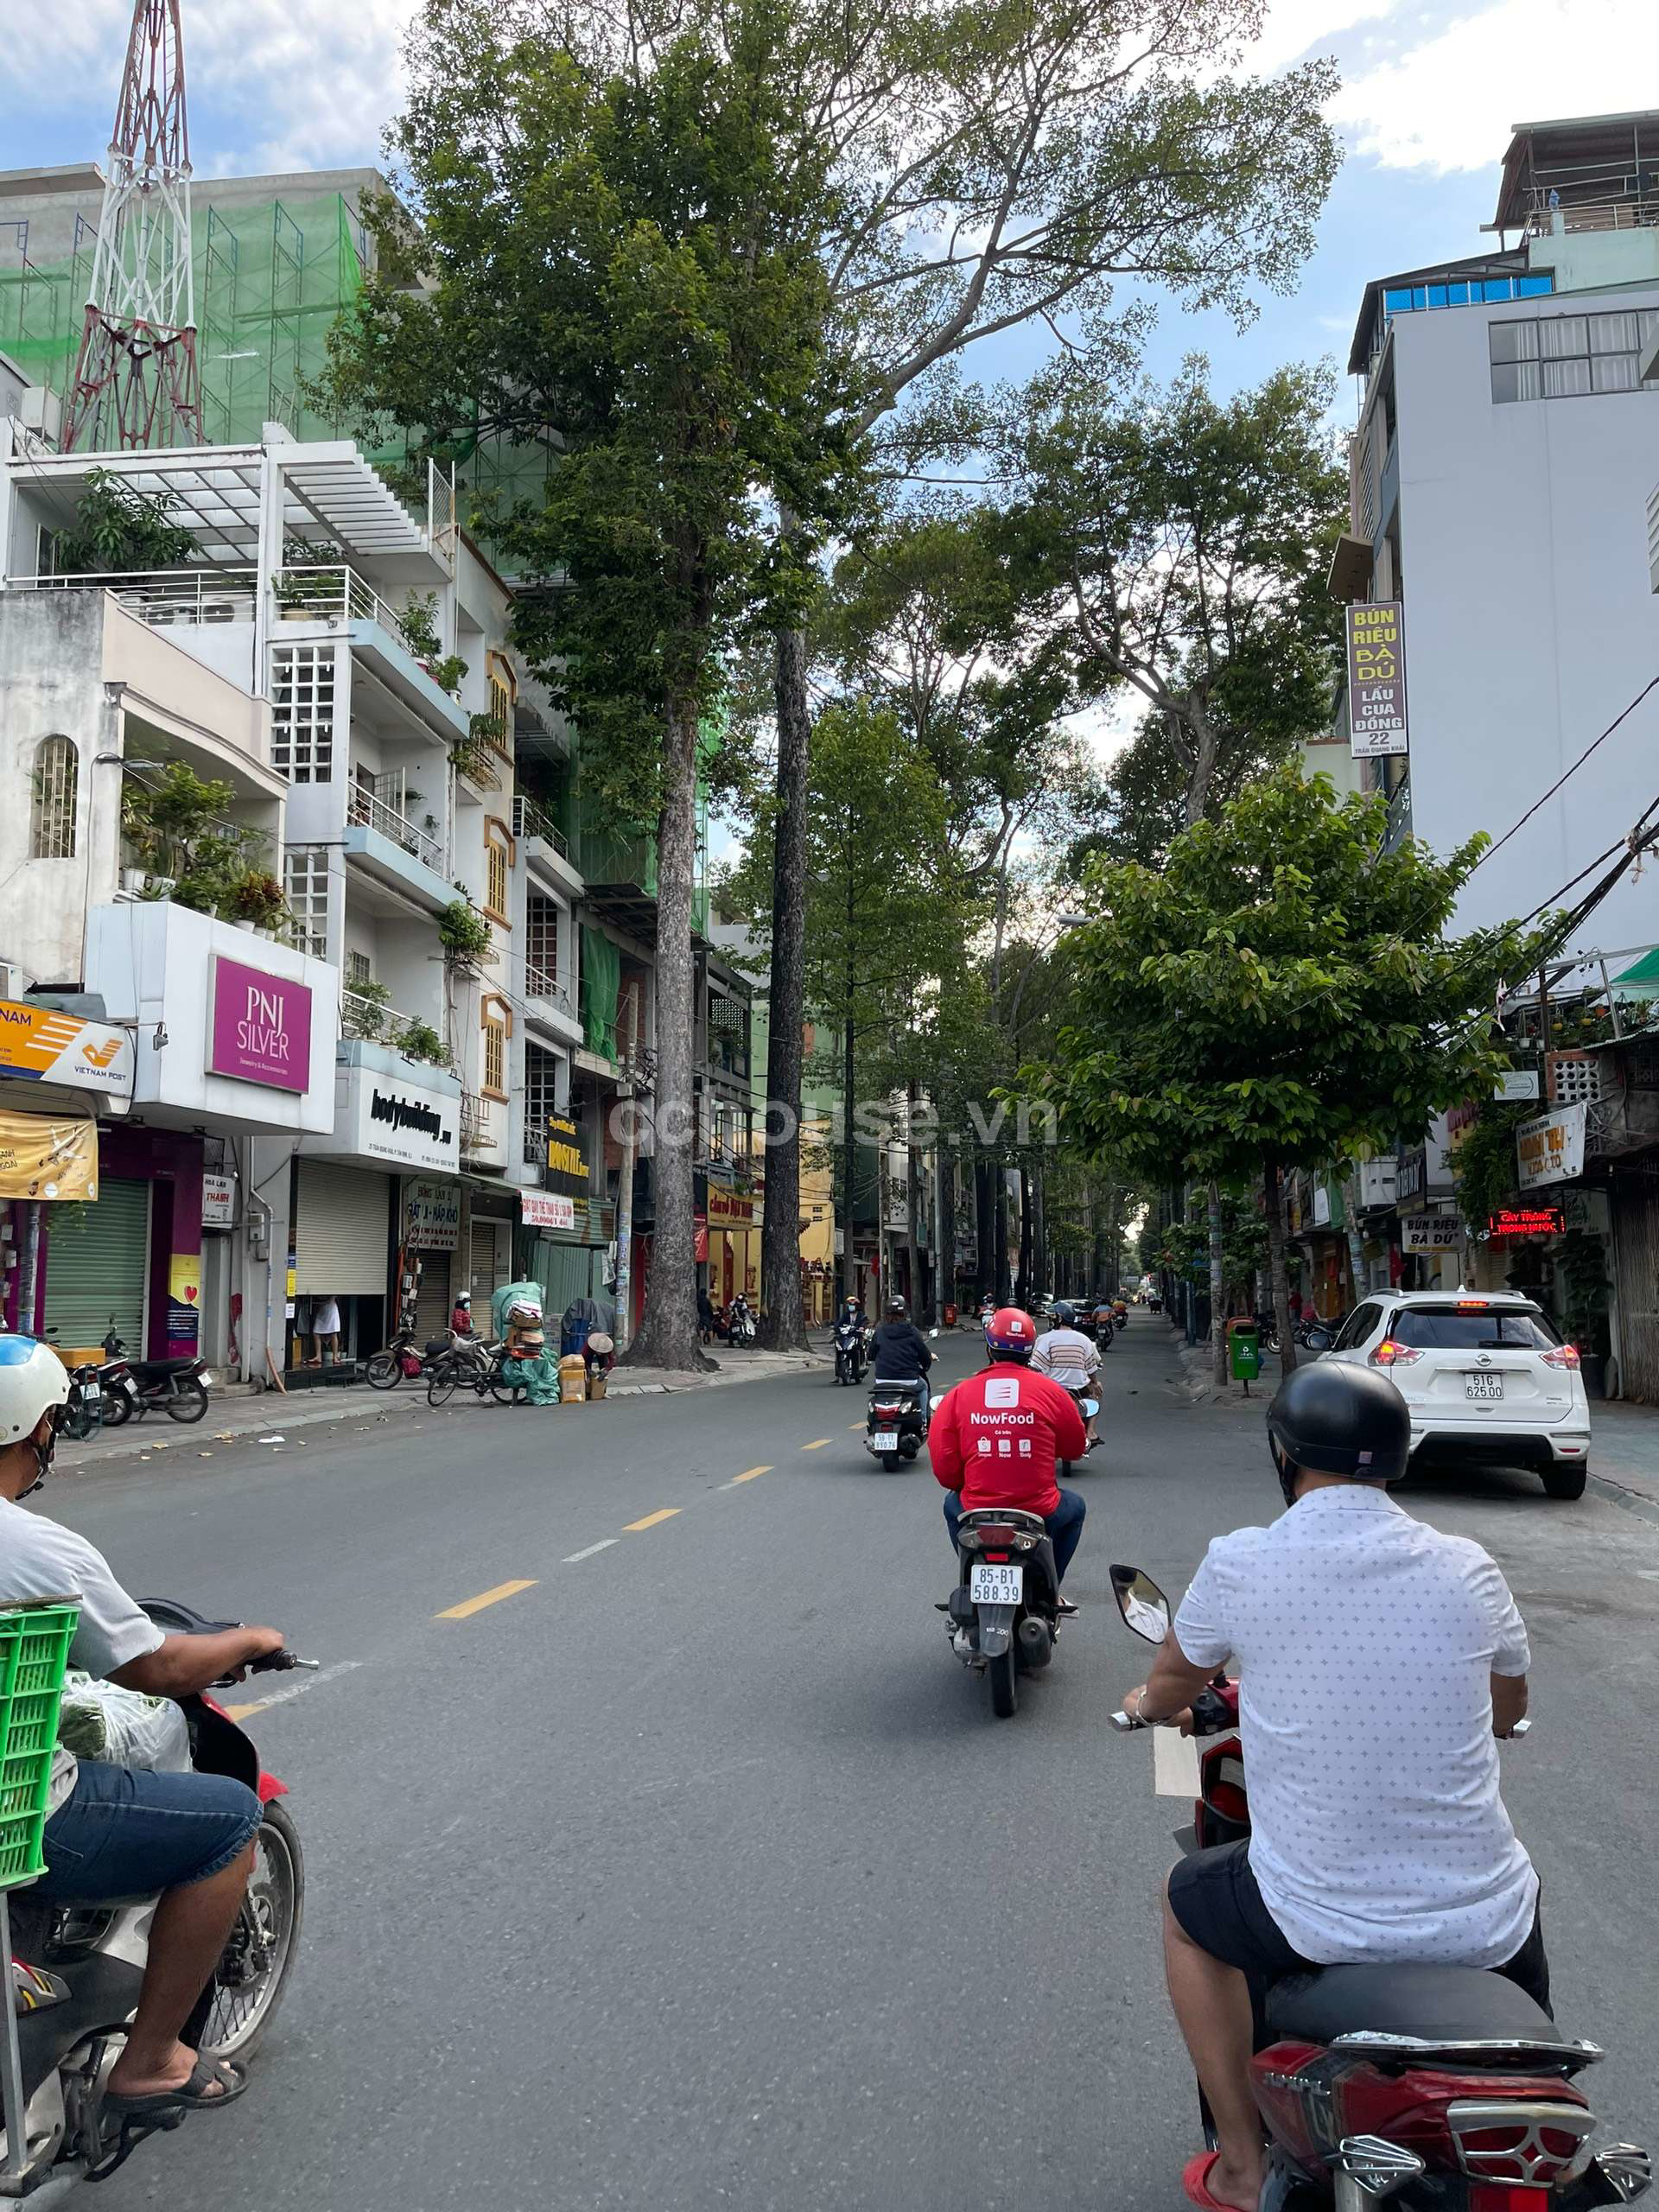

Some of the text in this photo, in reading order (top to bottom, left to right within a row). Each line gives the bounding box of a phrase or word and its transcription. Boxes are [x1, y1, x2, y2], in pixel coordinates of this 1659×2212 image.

[1354, 608, 1394, 626] BÚN
[1353, 626, 1397, 645] RIÊU
[1356, 645, 1395, 663] BÀ
[1357, 662, 1395, 680] DÚ
[1361, 702, 1395, 716] CUA
[1369, 732, 1389, 746] 22
[246, 985, 284, 1038] PNJ
[237, 1020, 289, 1061] SILVER
[74, 1065, 127, 1081] VIETNAM POST
[1408, 1217, 1430, 1230] BÚN
[1411, 1230, 1428, 1244] BÀ
[1473, 1375, 1493, 1386] 51G
[970, 1412, 1034, 1424] NowFood
[980, 1568, 1014, 1585] 85-B1
[975, 1585, 1019, 1602] 588.39
